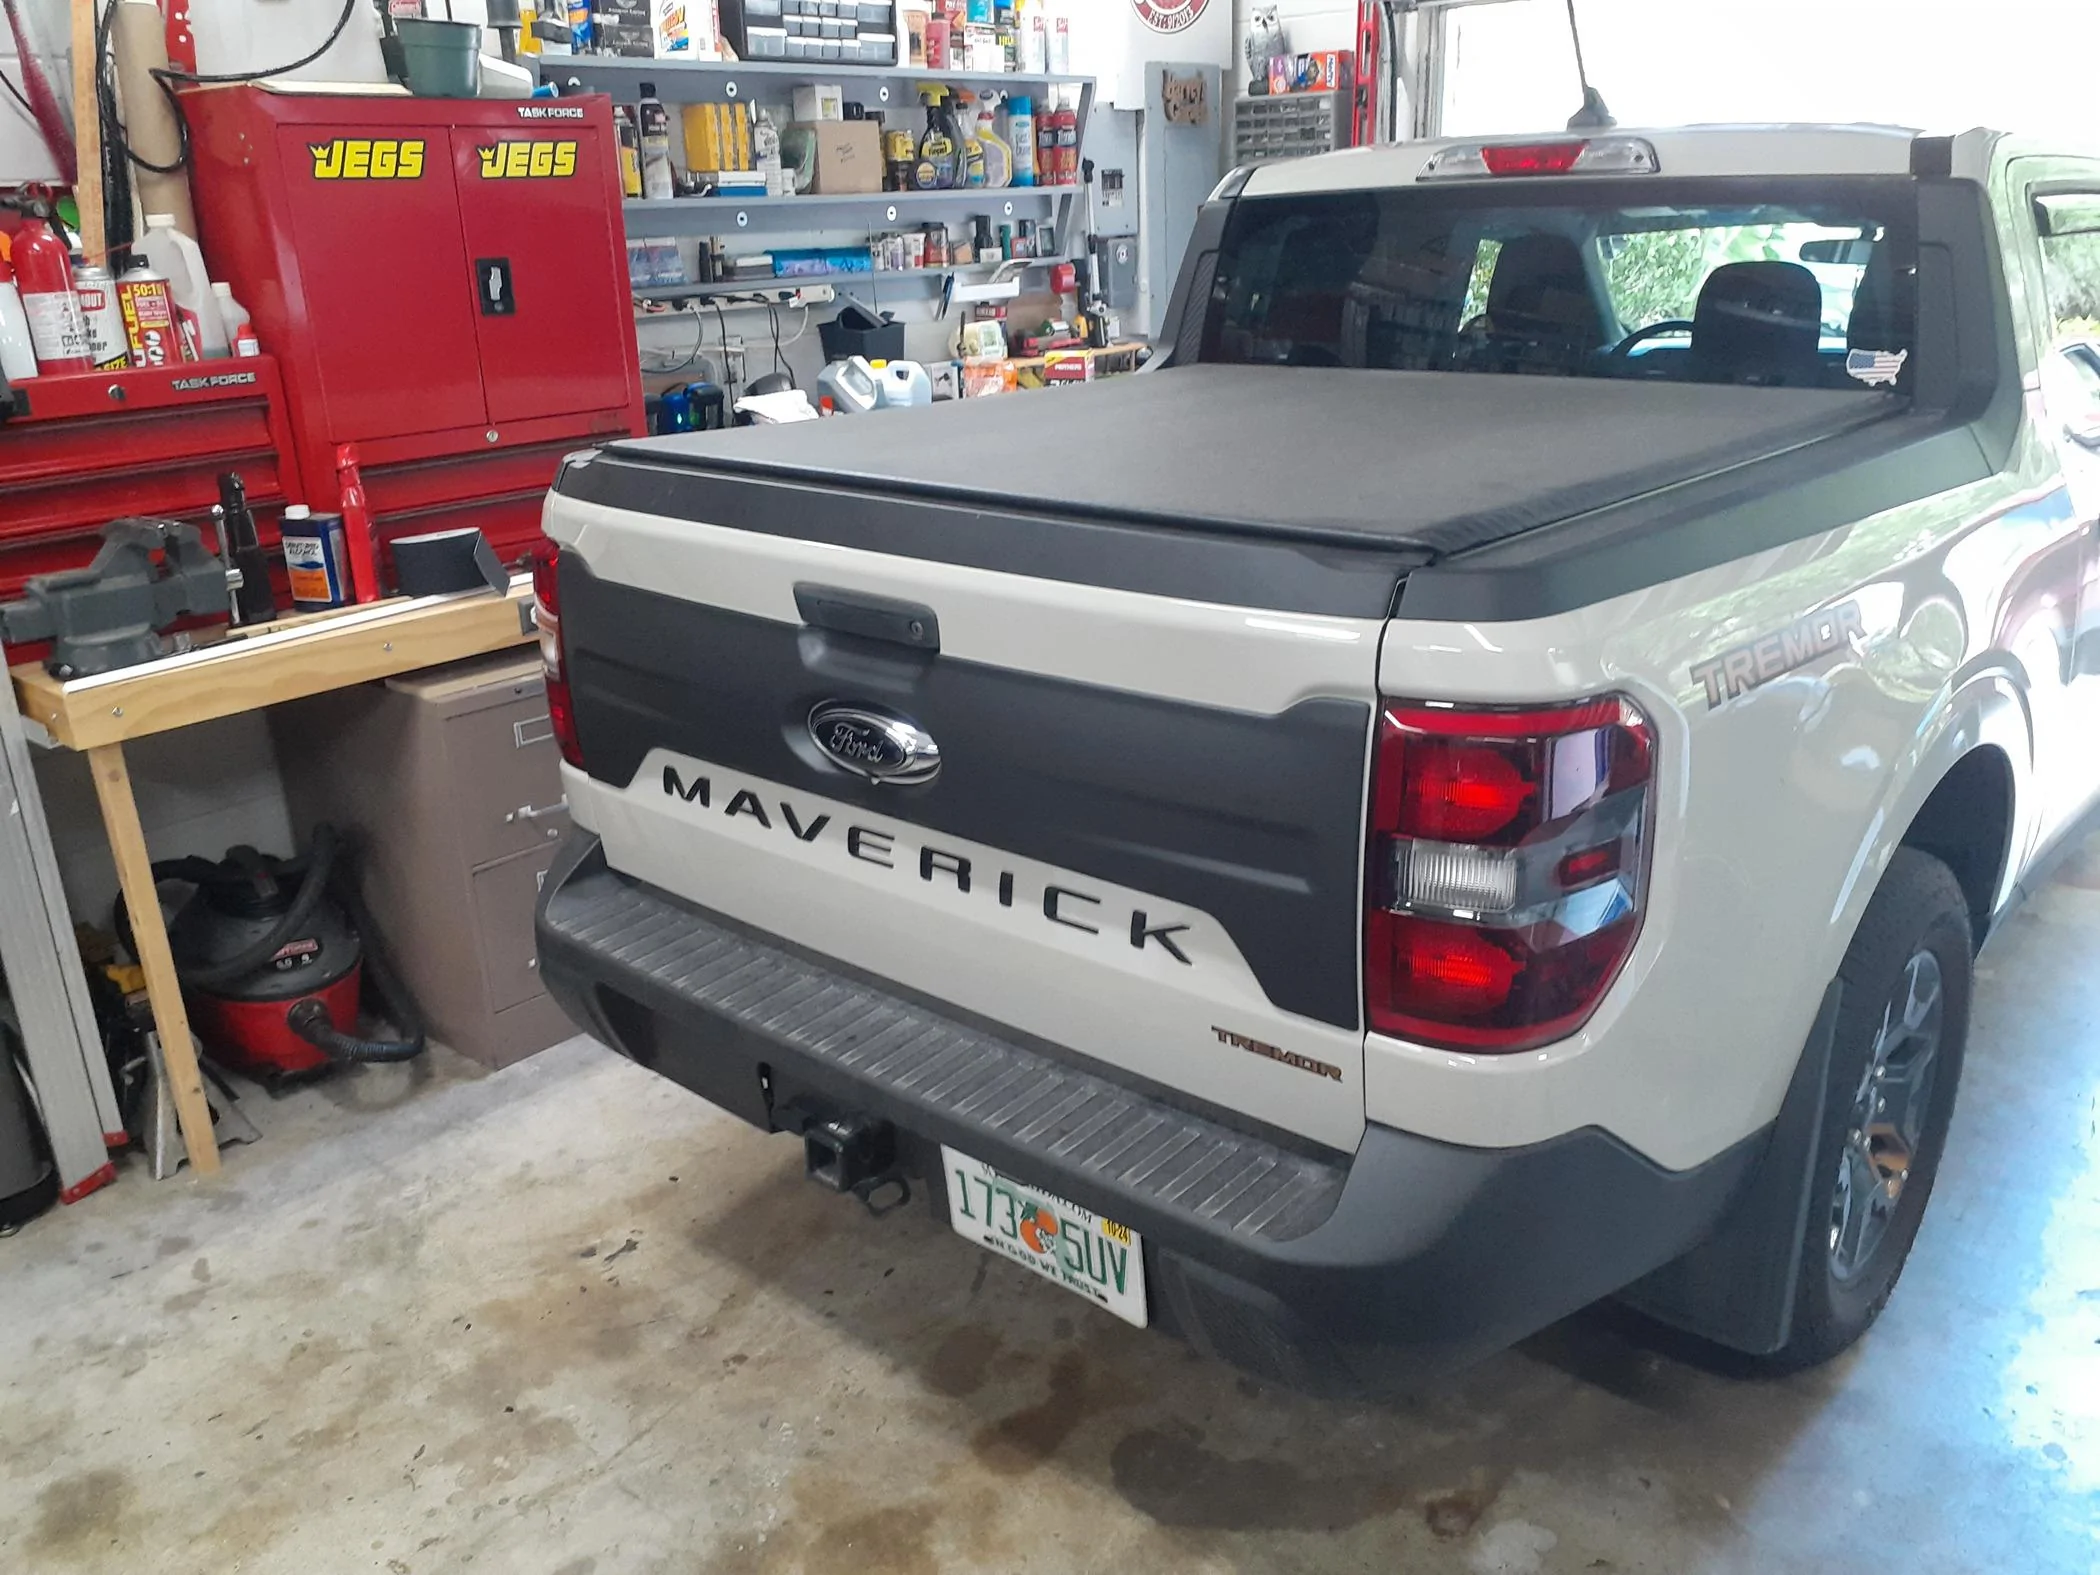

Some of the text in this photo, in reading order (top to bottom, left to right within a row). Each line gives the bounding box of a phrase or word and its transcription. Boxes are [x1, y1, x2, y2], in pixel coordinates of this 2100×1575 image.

[518, 107, 584, 118] TASK FORCE
[313, 139, 425, 179] JEGS
[480, 141, 577, 178] JEGS
[172, 372, 256, 390] TASK FORCE
[1689, 600, 1867, 711] TREMOR
[829, 722, 885, 764] Ford
[662, 765, 1193, 966] MAVERICK
[1211, 1025, 1343, 1083] TREMOR
